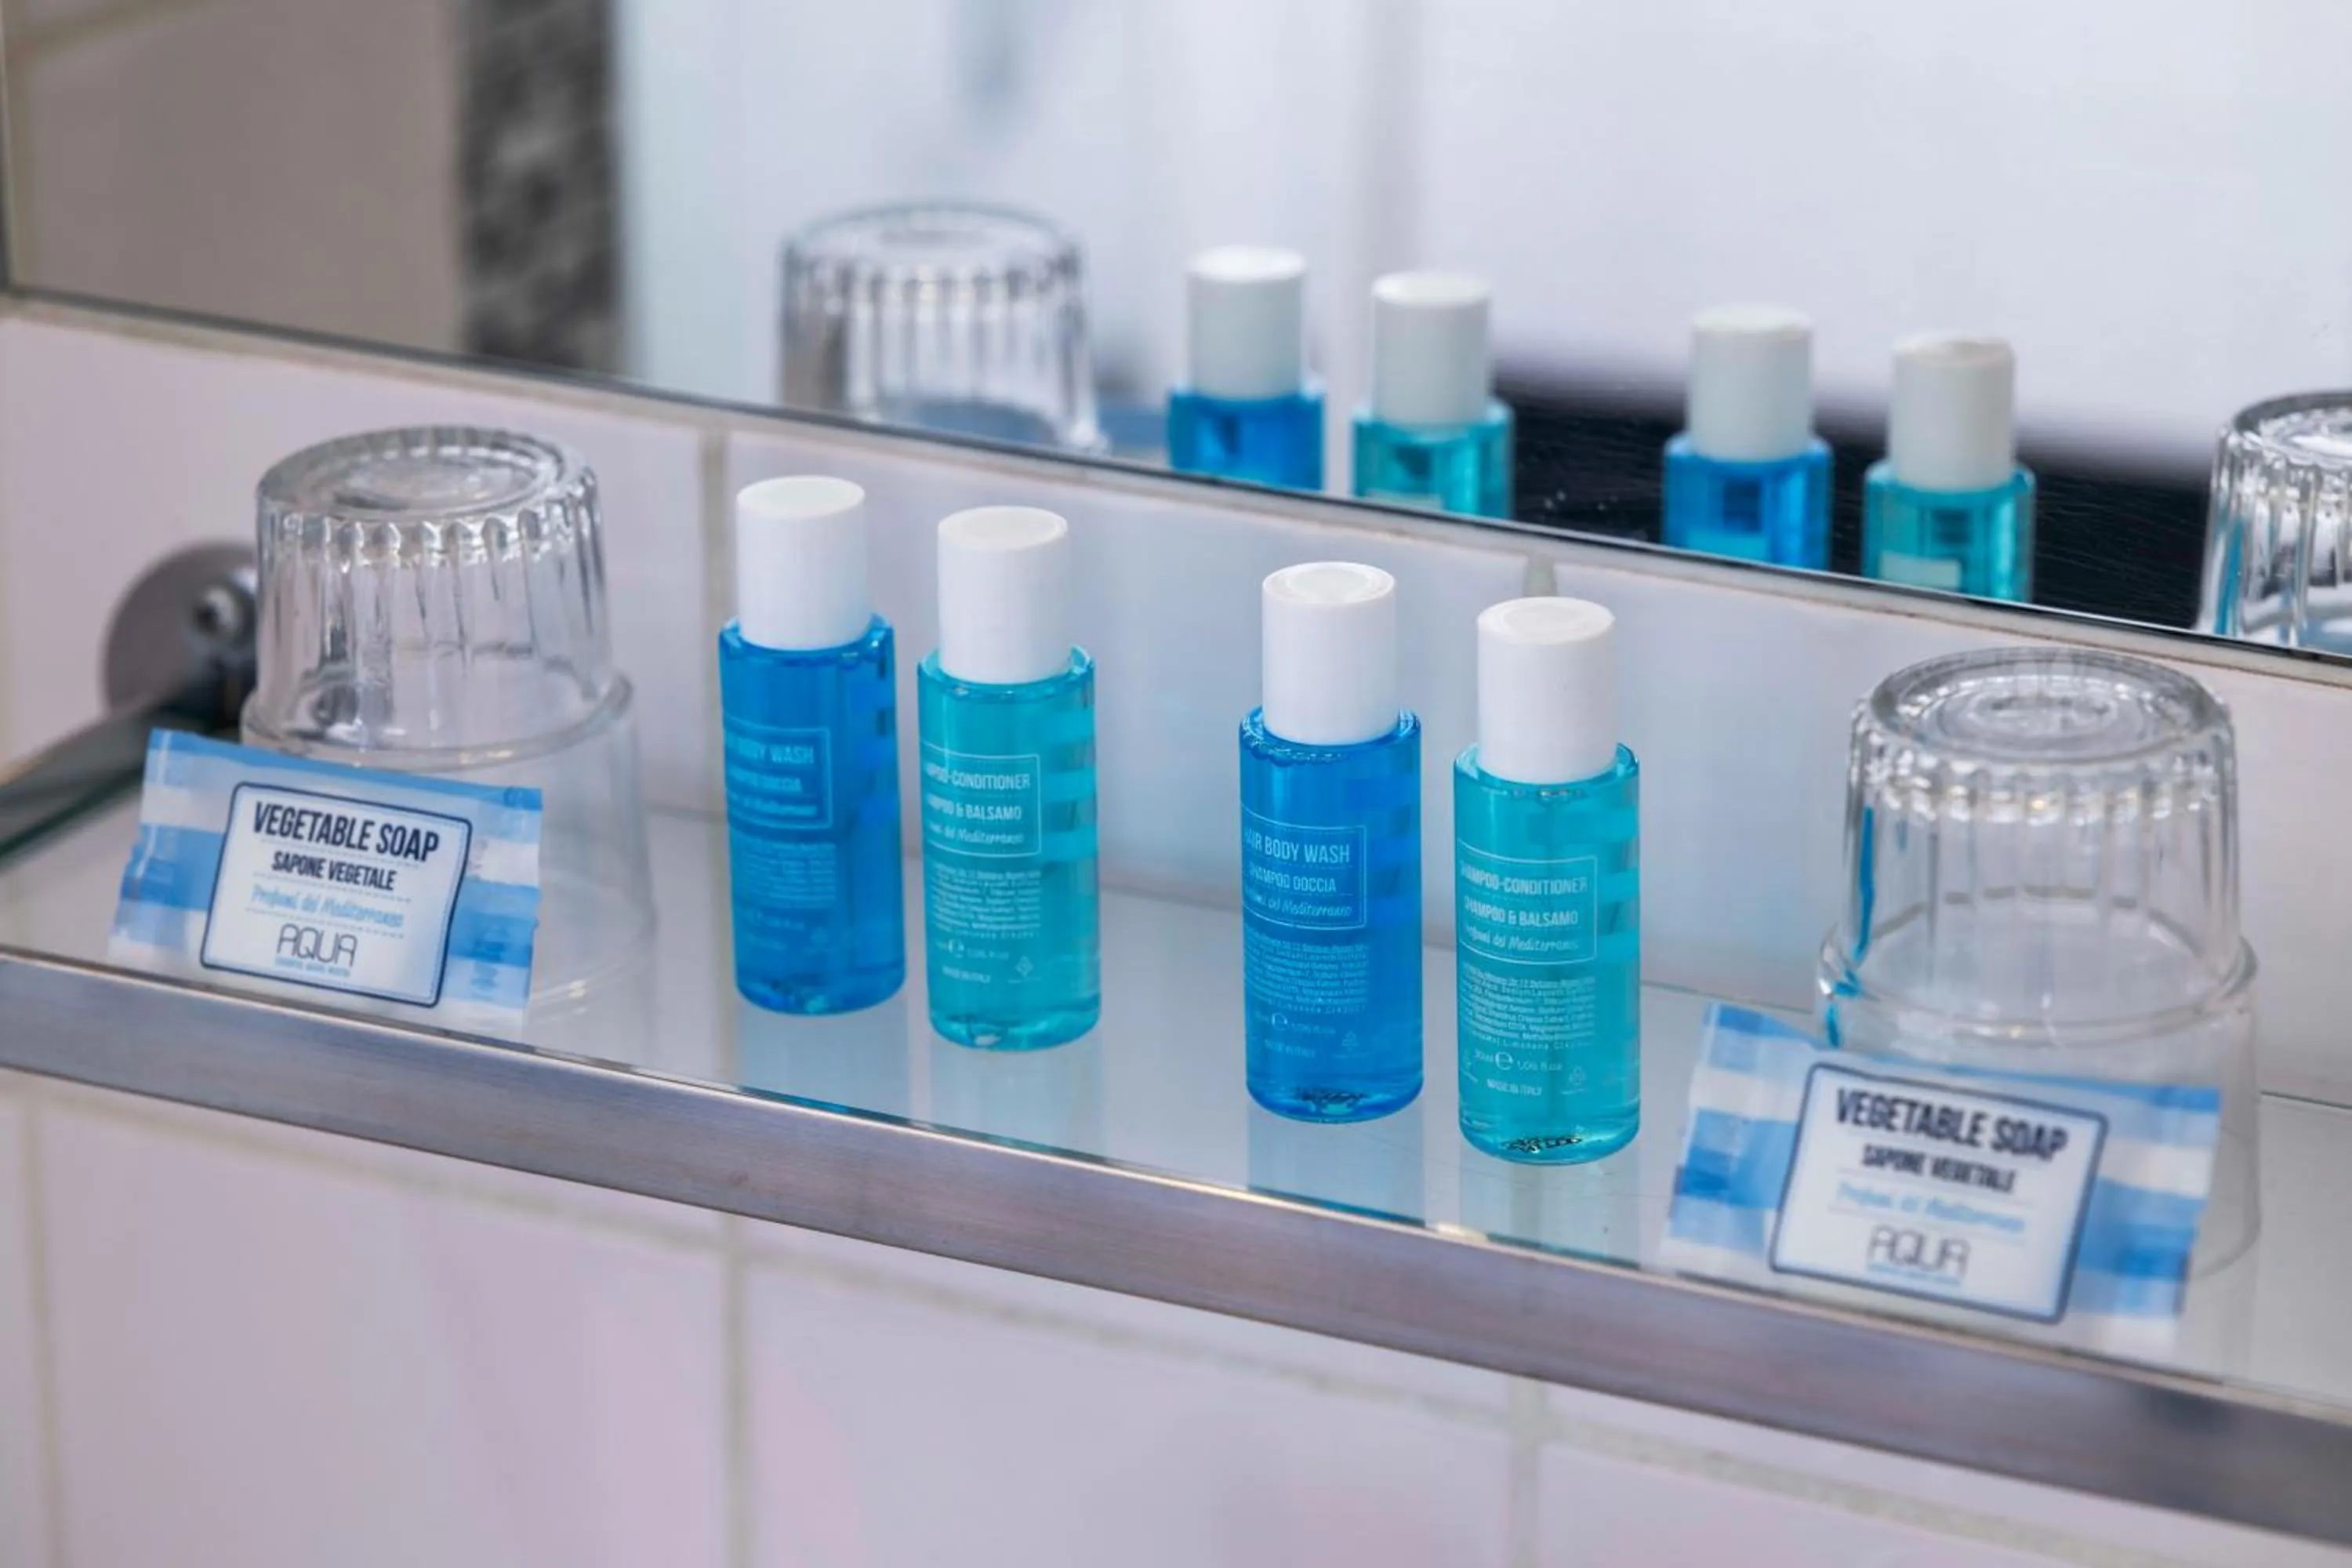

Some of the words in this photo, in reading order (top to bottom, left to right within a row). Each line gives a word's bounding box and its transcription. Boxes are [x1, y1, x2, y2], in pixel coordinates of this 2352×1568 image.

[770, 744, 814, 763] WASH
[964, 803, 1022, 821] BALSAMO
[252, 801, 376, 851] VEGETABLE
[376, 822, 440, 862] SOAP
[1265, 836, 1299, 862] BODY
[1304, 844, 1350, 863] WASH
[271, 850, 327, 879] SAPONE
[328, 858, 397, 891] VEGETALE
[1293, 876, 1337, 893] DOCCIA
[1519, 910, 1578, 927] BALSAMO
[277, 923, 358, 967] AQUA
[1837, 1087, 1987, 1147] VEGETABLE
[1991, 1116, 2068, 1161] SOAP
[1866, 1224, 1971, 1279] AQUA
